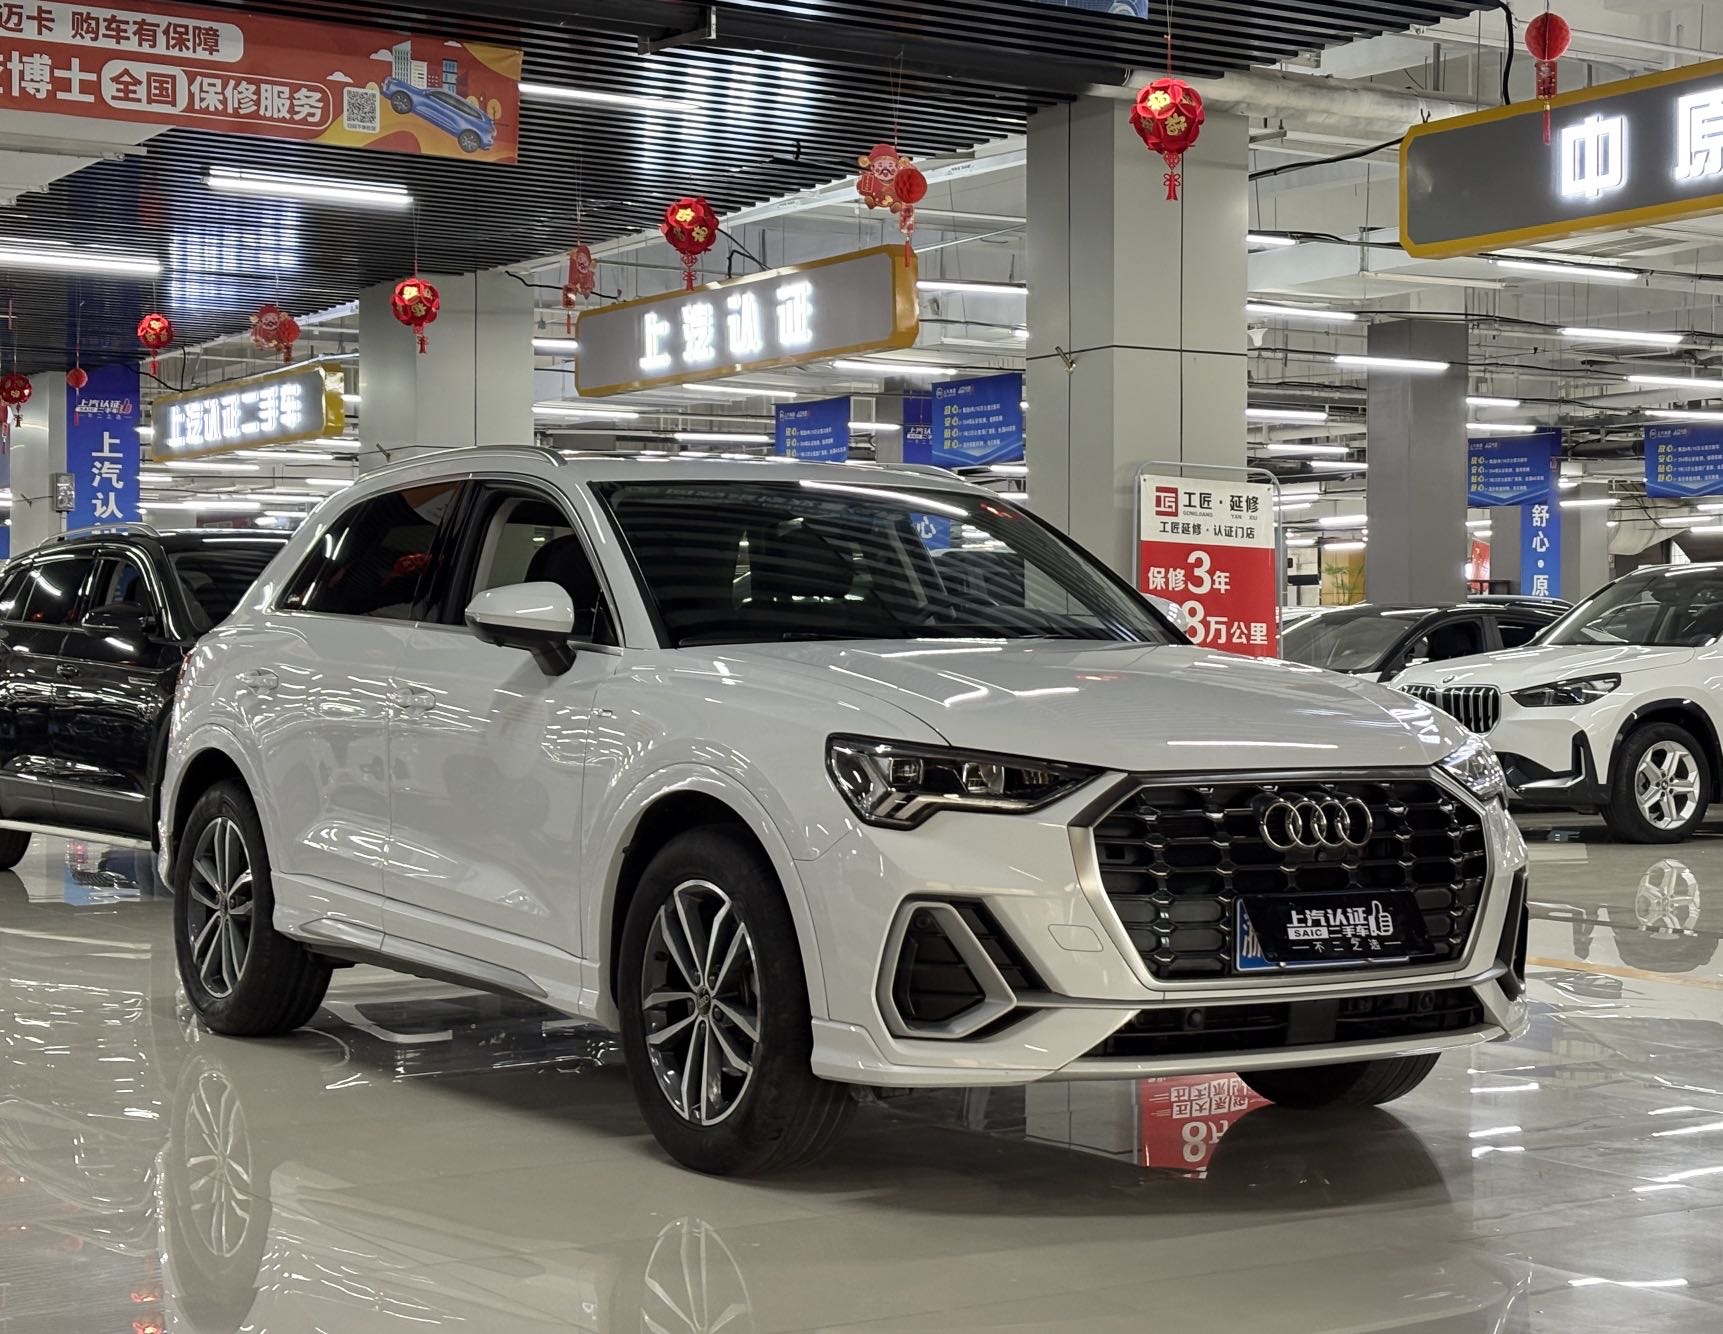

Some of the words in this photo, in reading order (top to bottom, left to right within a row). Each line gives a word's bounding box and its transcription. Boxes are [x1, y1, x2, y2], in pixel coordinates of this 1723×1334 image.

[0, 3, 55, 36] 迈卡
[71, 11, 220, 55] 购车有保障
[0, 51, 97, 103] 博士
[110, 68, 177, 108] 全国
[190, 75, 323, 122] 保修服务
[1160, 521, 1255, 539] 工匠延修·认证门店
[1148, 550, 1231, 595] 保修3年
[1182, 600, 1269, 645] 8万公里
[1287, 907, 1369, 928] 上汽认证
[1294, 929, 1323, 938] SAIC
[1329, 926, 1371, 938] 二手车
[1313, 939, 1382, 953] 不二之选
